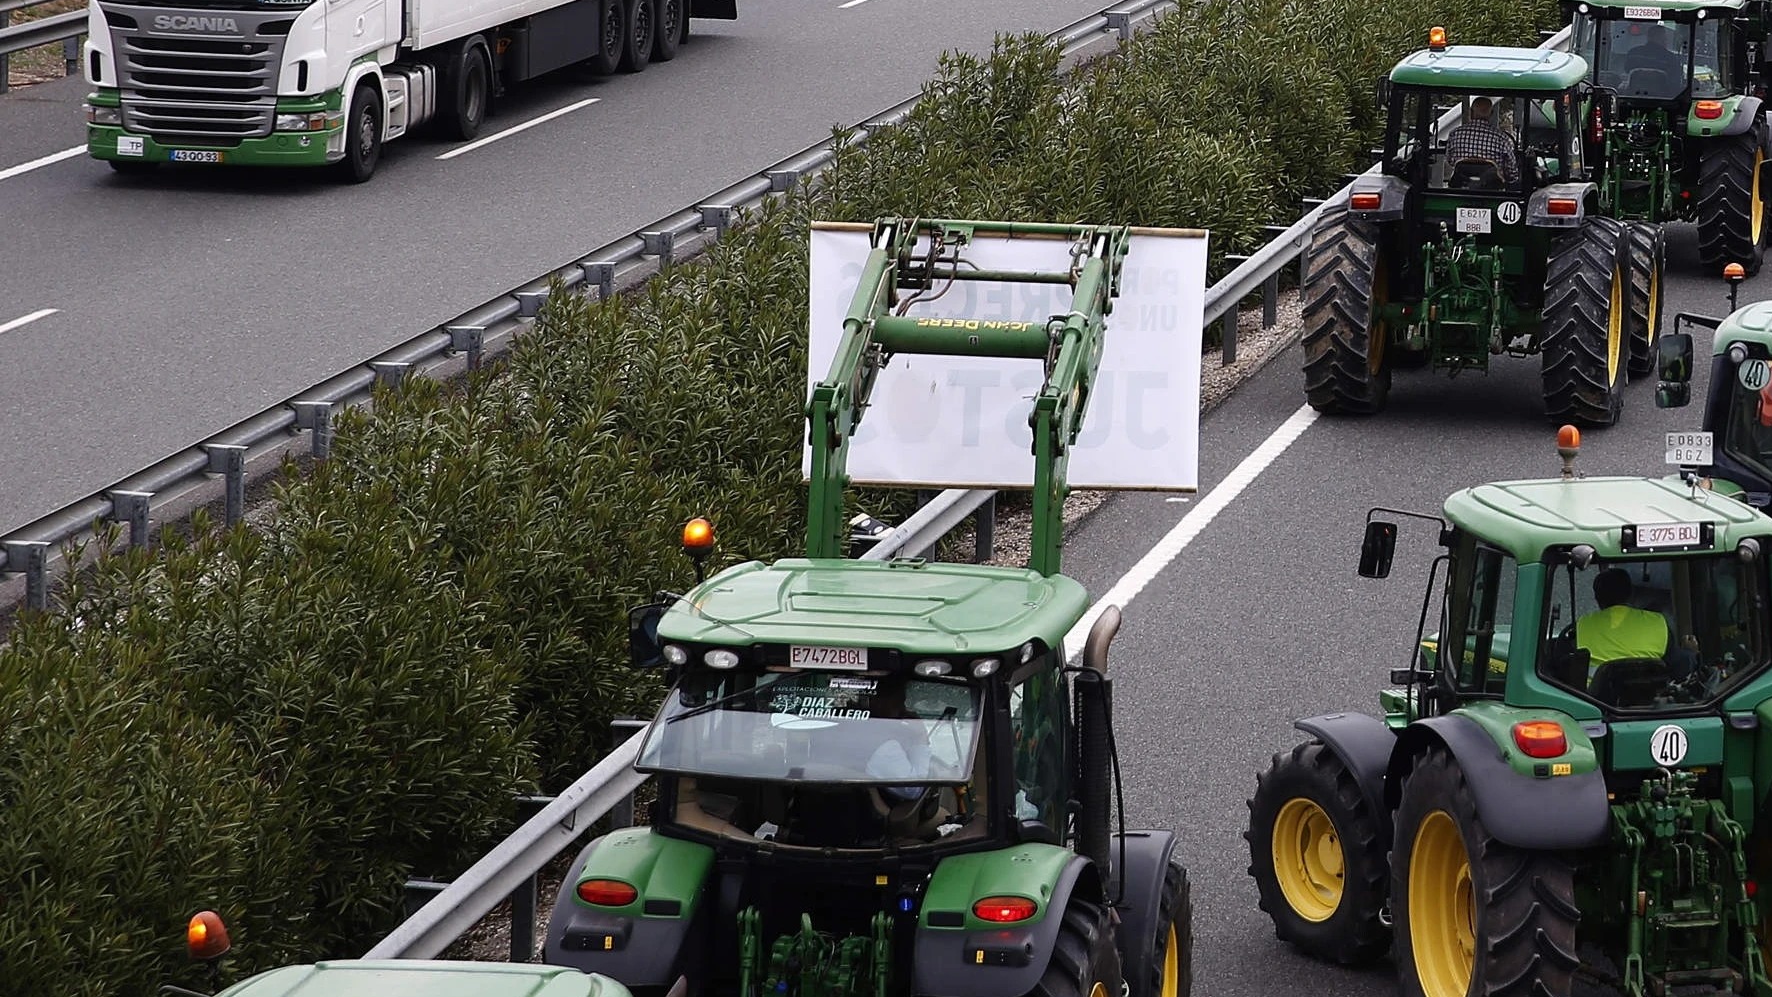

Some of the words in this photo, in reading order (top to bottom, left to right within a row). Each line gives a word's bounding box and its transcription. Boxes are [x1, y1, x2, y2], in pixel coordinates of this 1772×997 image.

[154, 15, 239, 33] SCANIA
[129, 141, 143, 150] TP
[1502, 203, 1516, 223] 40
[917, 317, 979, 330] DEERE
[1744, 360, 1762, 388] 40
[1675, 450, 1703, 462] BGZ
[792, 647, 866, 665] E7472BGL
[801, 696, 836, 708] DIAZ
[798, 707, 871, 720] CABALLERO
